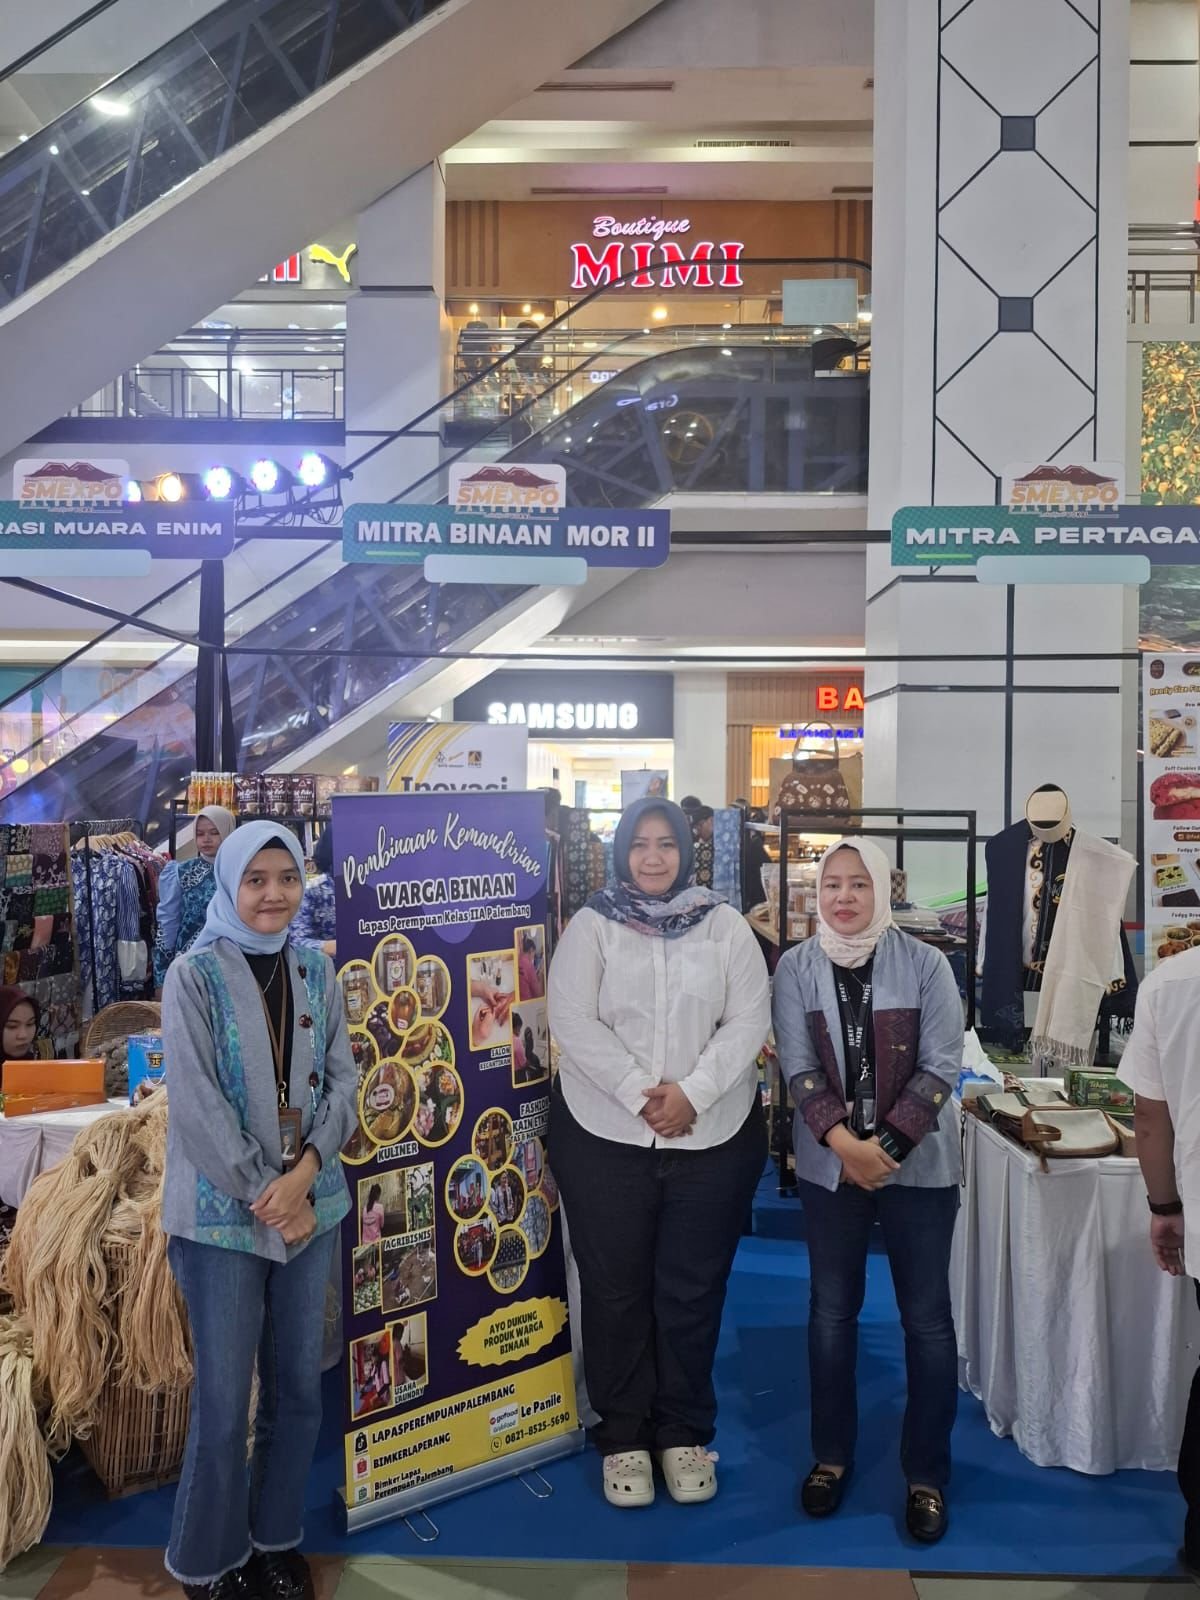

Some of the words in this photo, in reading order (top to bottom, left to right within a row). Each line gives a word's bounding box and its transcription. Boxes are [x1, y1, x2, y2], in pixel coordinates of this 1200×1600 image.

[592, 215, 691, 241] Boutique
[570, 242, 744, 288] MIMI
[20, 480, 124, 499] SMEXPO
[456, 484, 560, 506] SMEXPO
[1009, 483, 1119, 503] SMEXPO
[0, 521, 45, 535] ASI
[54, 521, 147, 535] MUARA
[156, 522, 222, 536] ENIM
[357, 520, 443, 545] MITRA
[450, 522, 551, 546] BINAAN
[567, 525, 629, 547] MOR
[637, 526, 655, 547] II
[906, 527, 1020, 545] MITRA
[1034, 526, 1200, 545] PERTAGA
[487, 702, 638, 730] SAMSUNG
[343, 826, 438, 898] Pembinaan
[443, 812, 541, 877] Kemandirian
[377, 879, 447, 909] WARGA
[450, 873, 516, 902] BINAAN
[359, 918, 389, 936] Lapas
[390, 913, 443, 932] Perempuan
[444, 911, 469, 925] Kelas
[470, 908, 486, 921] IIA
[486, 904, 531, 920] Palembang
[512, 1117, 533, 1133] KAIN
[377, 1141, 419, 1163] KULINER
[384, 1229, 432, 1251] AGRIBISNIS
[483, 1330, 515, 1349] PRODUK
[515, 1320, 544, 1338] WARGA
[489, 1320, 506, 1335] AYO
[507, 1310, 538, 1329] DUKUNG
[500, 1336, 530, 1355] BINAAN
[394, 1381, 417, 1396] USAHA
[394, 1386, 424, 1405] LAUNDRY
[372, 1384, 515, 1444] LAPASPEREMPUANPALEMBANG
[521, 1405, 531, 1418] Le
[533, 1393, 562, 1413] Panile
[505, 1412, 570, 1444] 0821-8525-5690
[373, 1432, 451, 1469] BIMKERLAPERANG
[374, 1475, 400, 1491] Bimker
[401, 1467, 421, 1481] Lapas
[374, 1480, 415, 1499] Perempuan
[416, 1464, 454, 1484] Palembang
